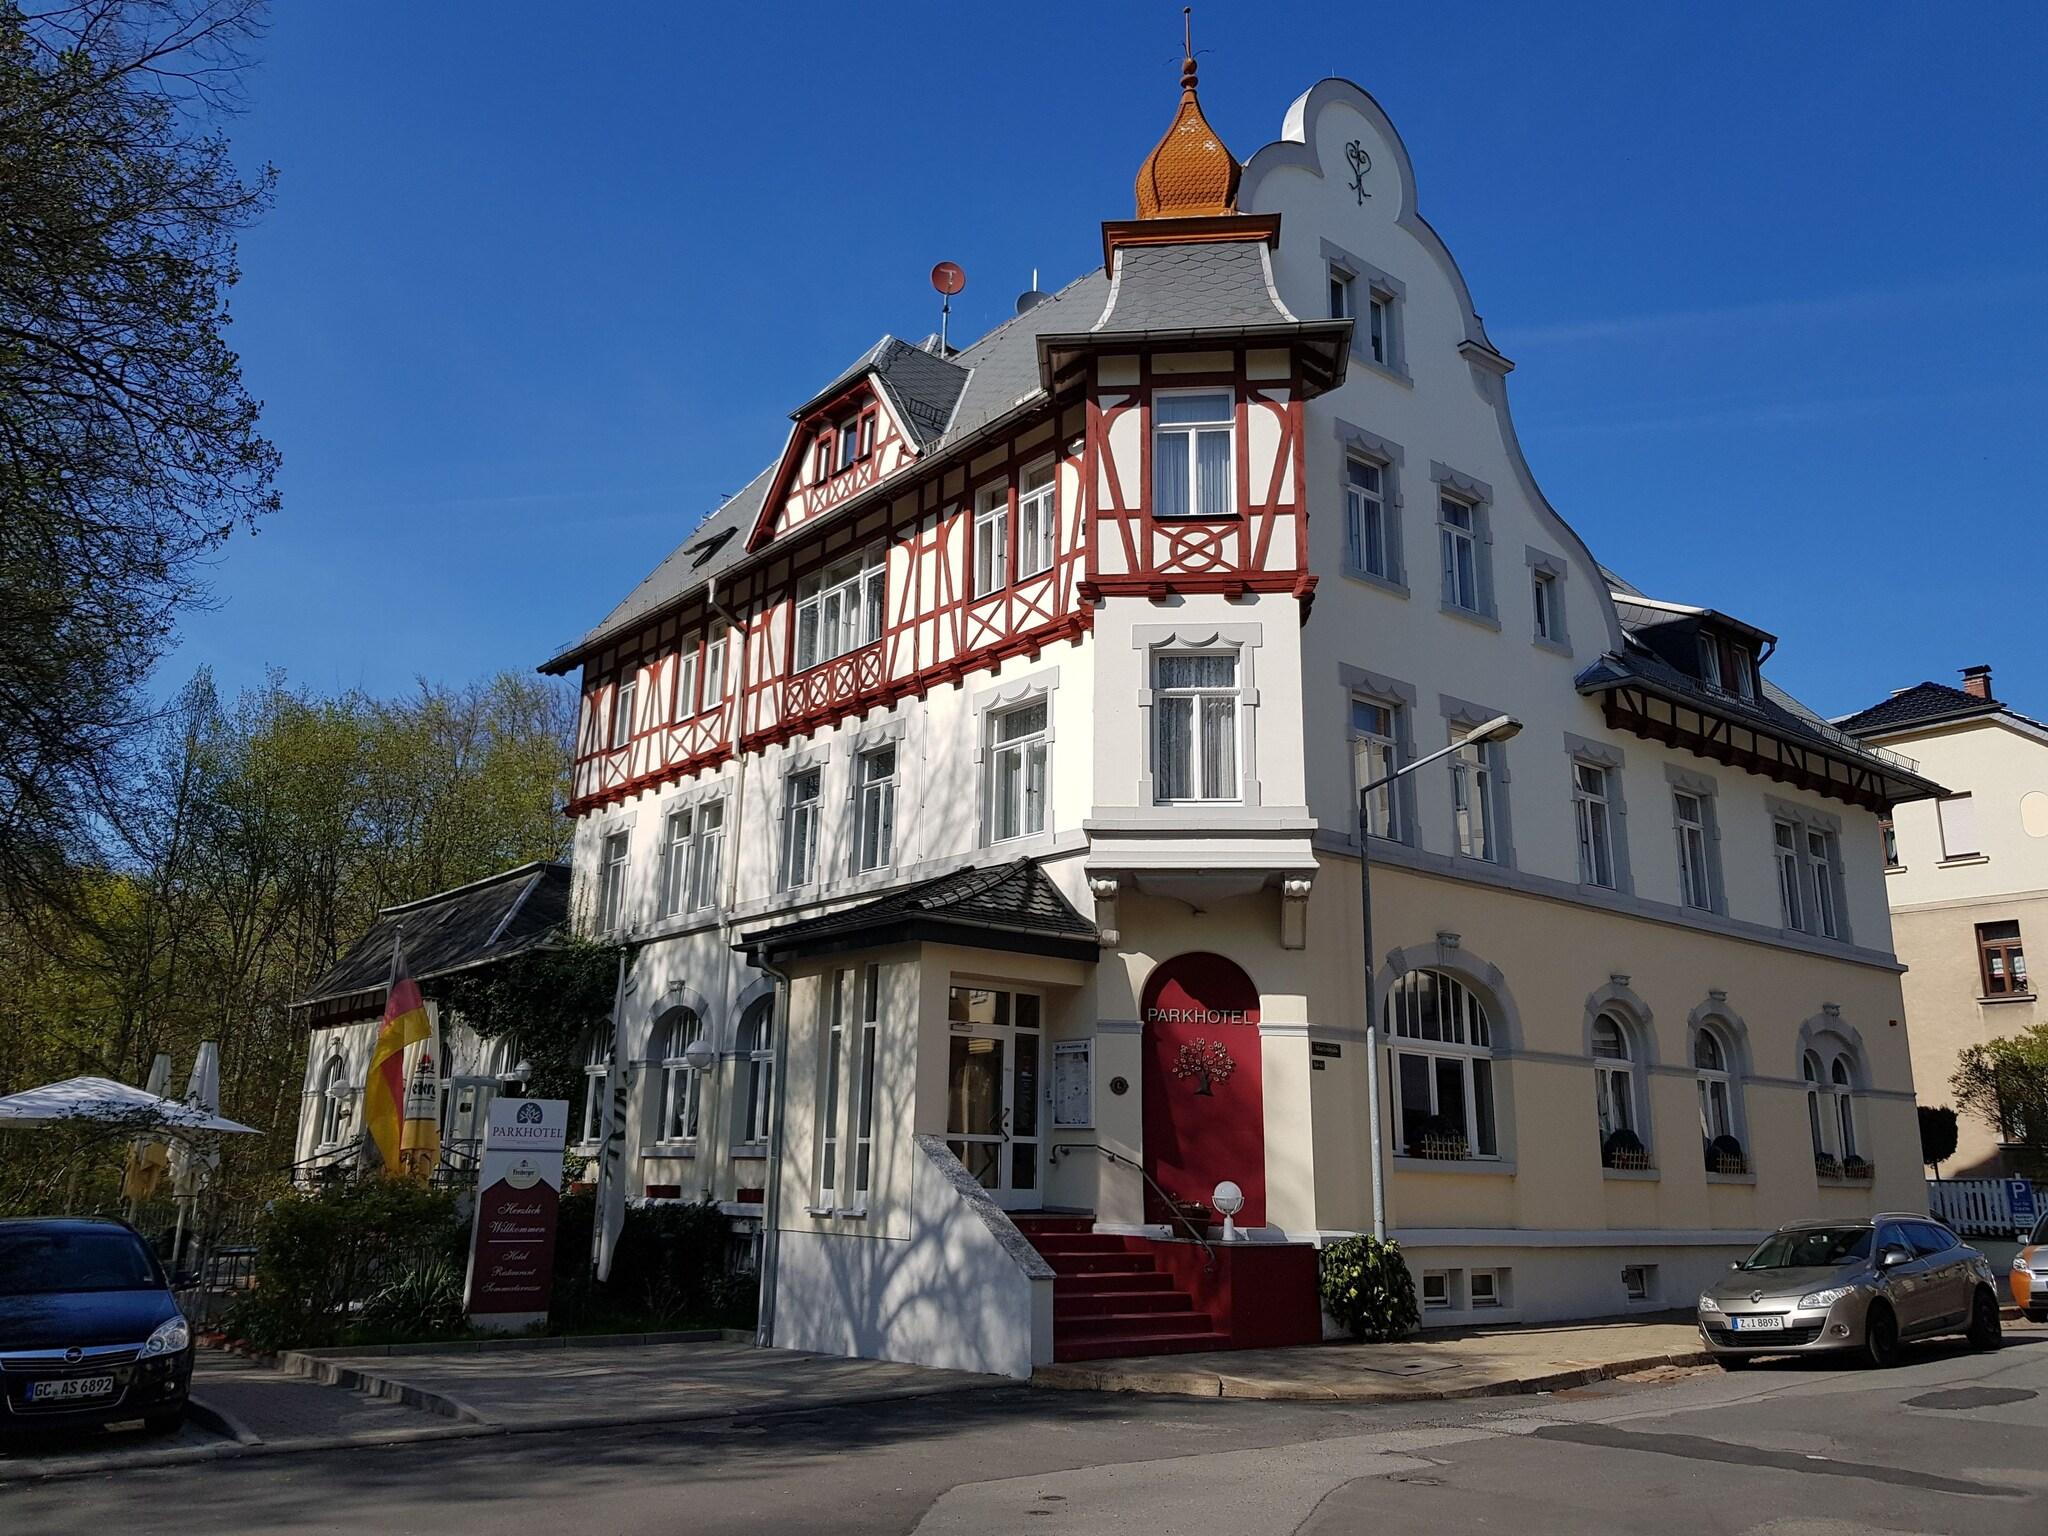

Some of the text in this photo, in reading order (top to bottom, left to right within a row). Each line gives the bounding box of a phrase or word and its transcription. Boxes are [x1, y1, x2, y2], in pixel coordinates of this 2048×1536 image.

[1147, 1007, 1254, 1025] PARKHOTEL
[492, 1126, 563, 1138] PARKHOTEL
[2011, 1182, 2026, 1199] P
[498, 1203, 542, 1215] Herzlich
[489, 1221, 546, 1233] Willkommen
[502, 1250, 530, 1261] Hotel
[1758, 1317, 1779, 1328] 8893
[35, 1378, 112, 1396] GC AS 6892
